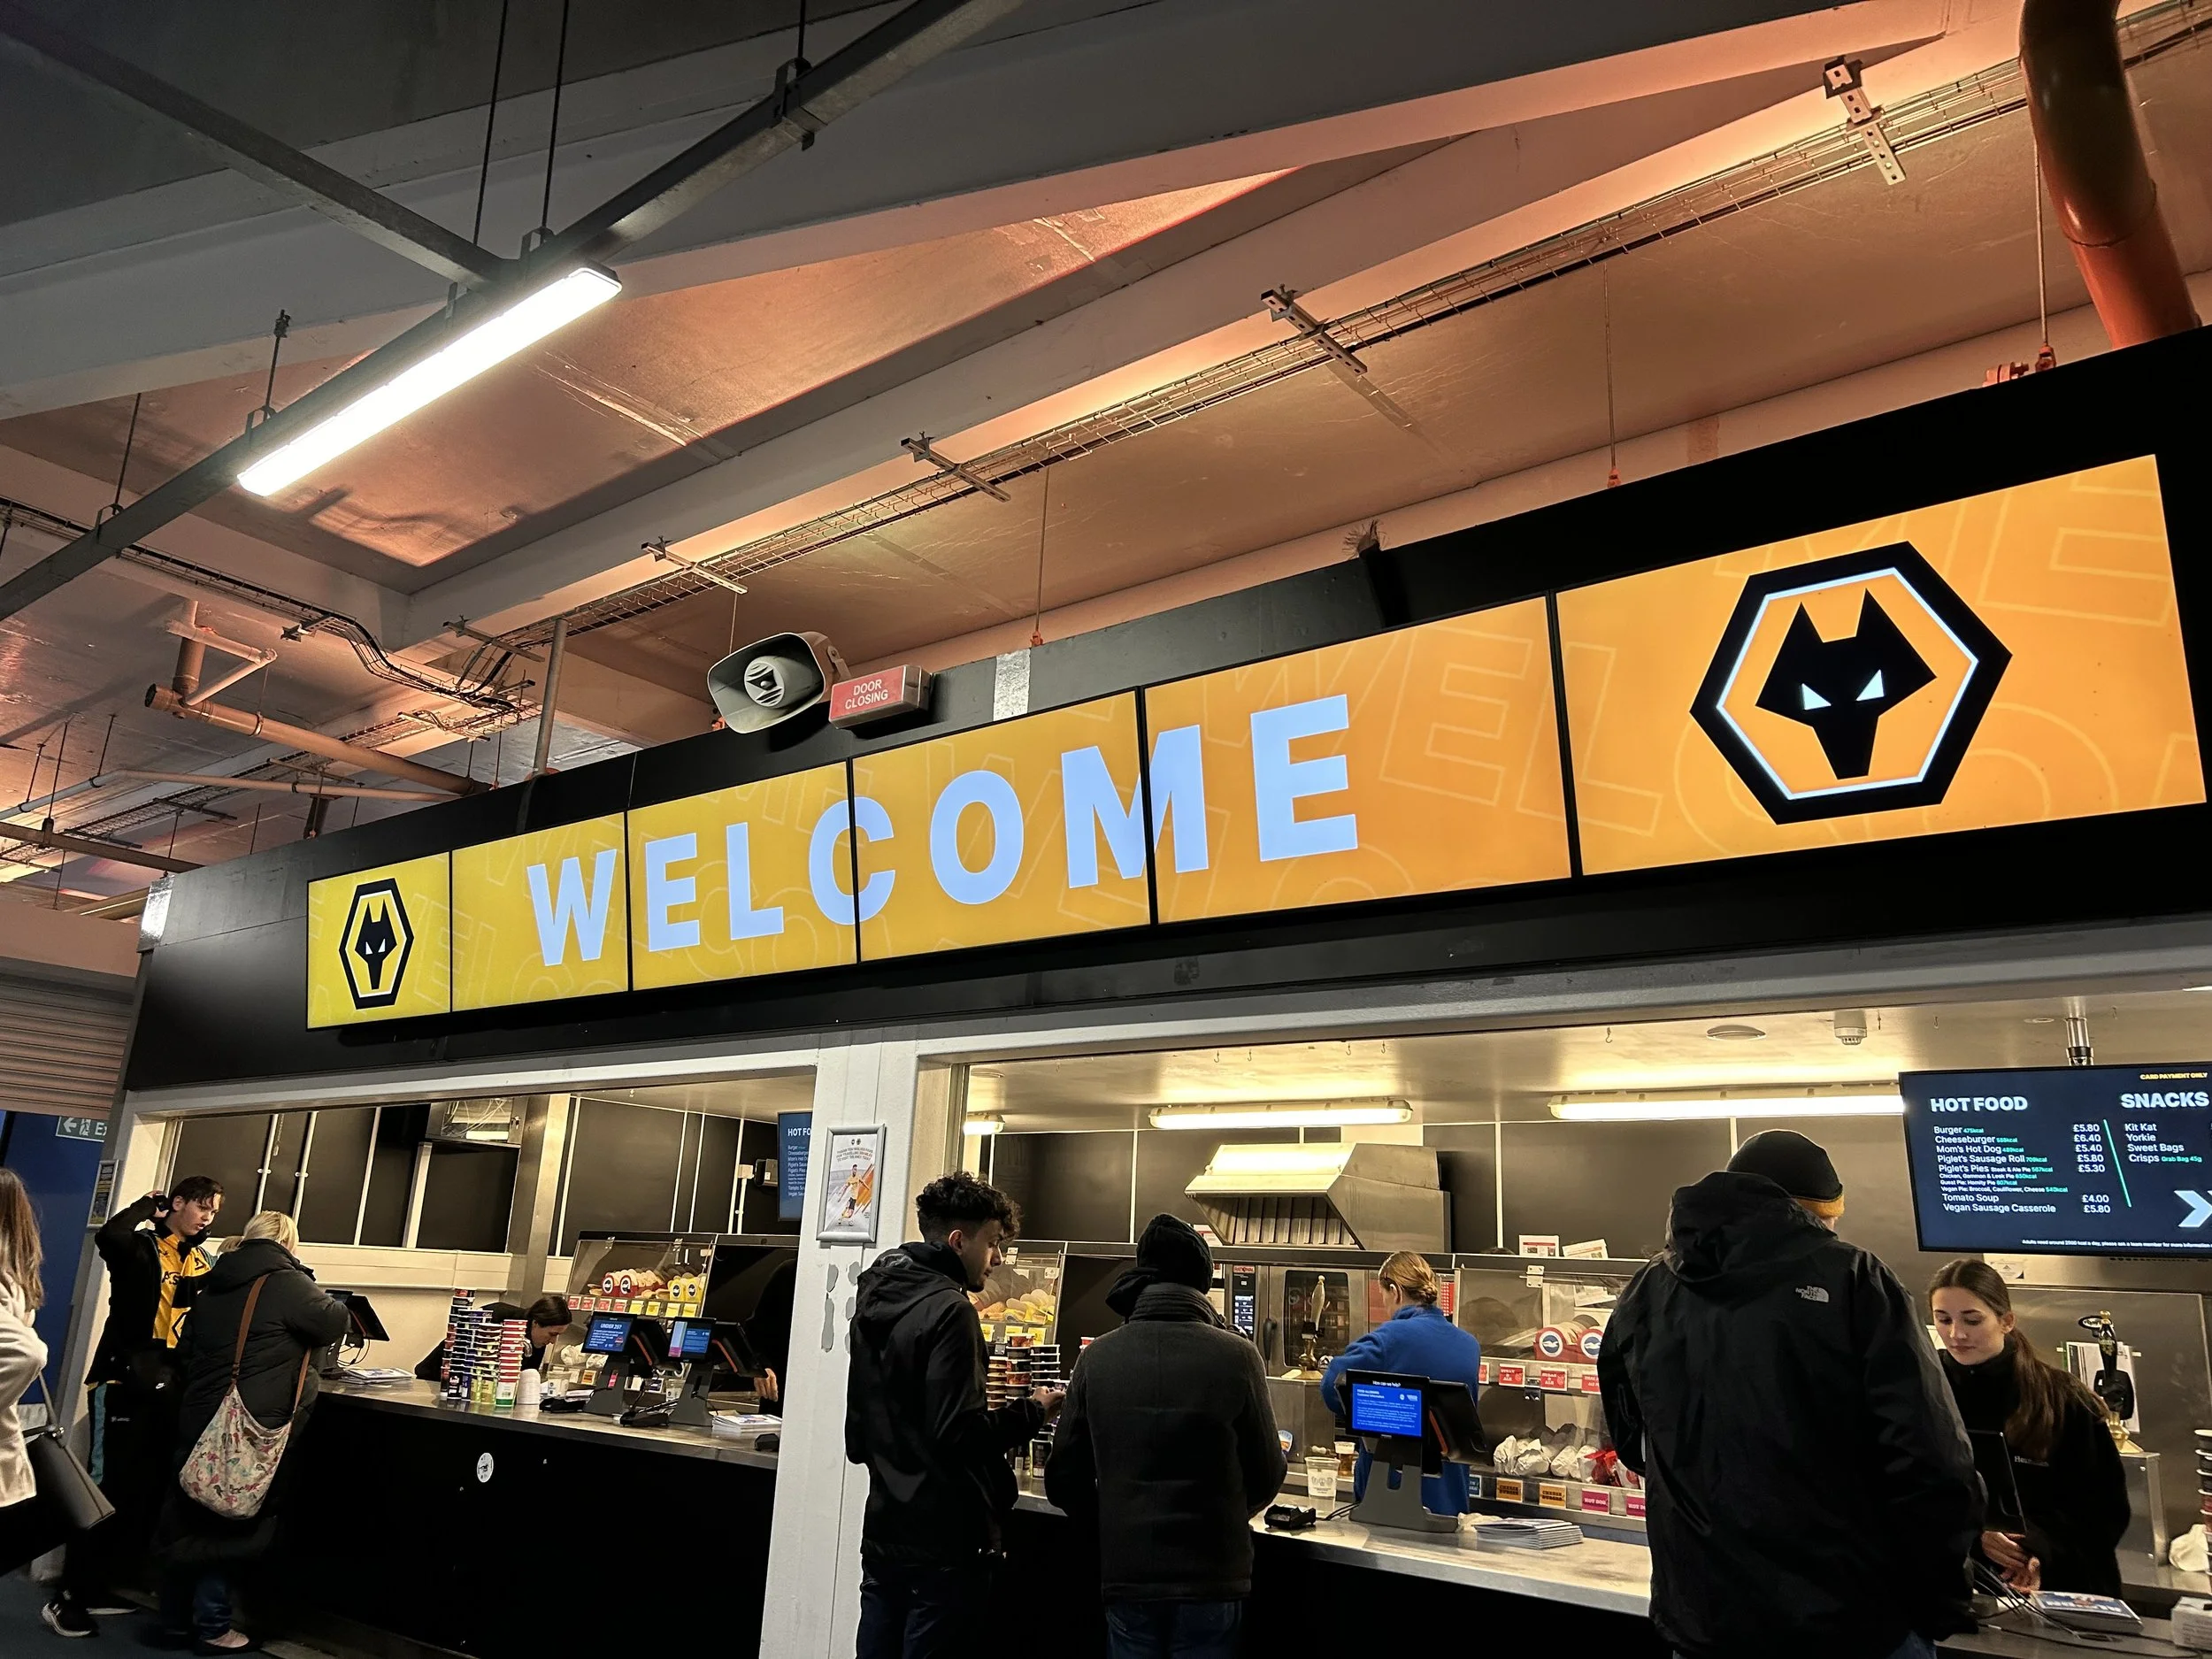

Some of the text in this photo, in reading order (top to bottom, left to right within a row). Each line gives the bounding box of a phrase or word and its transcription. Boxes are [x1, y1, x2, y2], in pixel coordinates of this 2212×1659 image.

[853, 679, 882, 696] DOOR
[845, 691, 888, 710] CLOSING
[526, 694, 1358, 967] WELCOME
[1930, 1095, 2028, 1112] HOT FOOD
[2121, 1092, 2209, 1108] SNACKS
[787, 1126, 811, 1137] HOT FO
[1933, 1125, 1962, 1135] Burger
[2073, 1124, 2100, 1133] £5.80
[1935, 1135, 1995, 1145] Cheeseburger
[2074, 1133, 2101, 1142] £6.40
[1983, 1145, 2001, 1155] Dog
[2127, 1143, 2185, 1153] Sweet Bags
[1938, 1155, 1968, 1164] Piglet's
[1969, 1155, 2007, 1164] Sausage
[2077, 1154, 2104, 1163] £5.80
[2129, 1154, 2160, 1164] Crisps
[1939, 1164, 1969, 1173] Piglet's
[1976, 1194, 2000, 1203] Soup
[2082, 1194, 2109, 1203] £4.00
[1943, 1203, 2056, 1213] Vegan Sausage Casserole
[2084, 1204, 2111, 1213] £5.80
